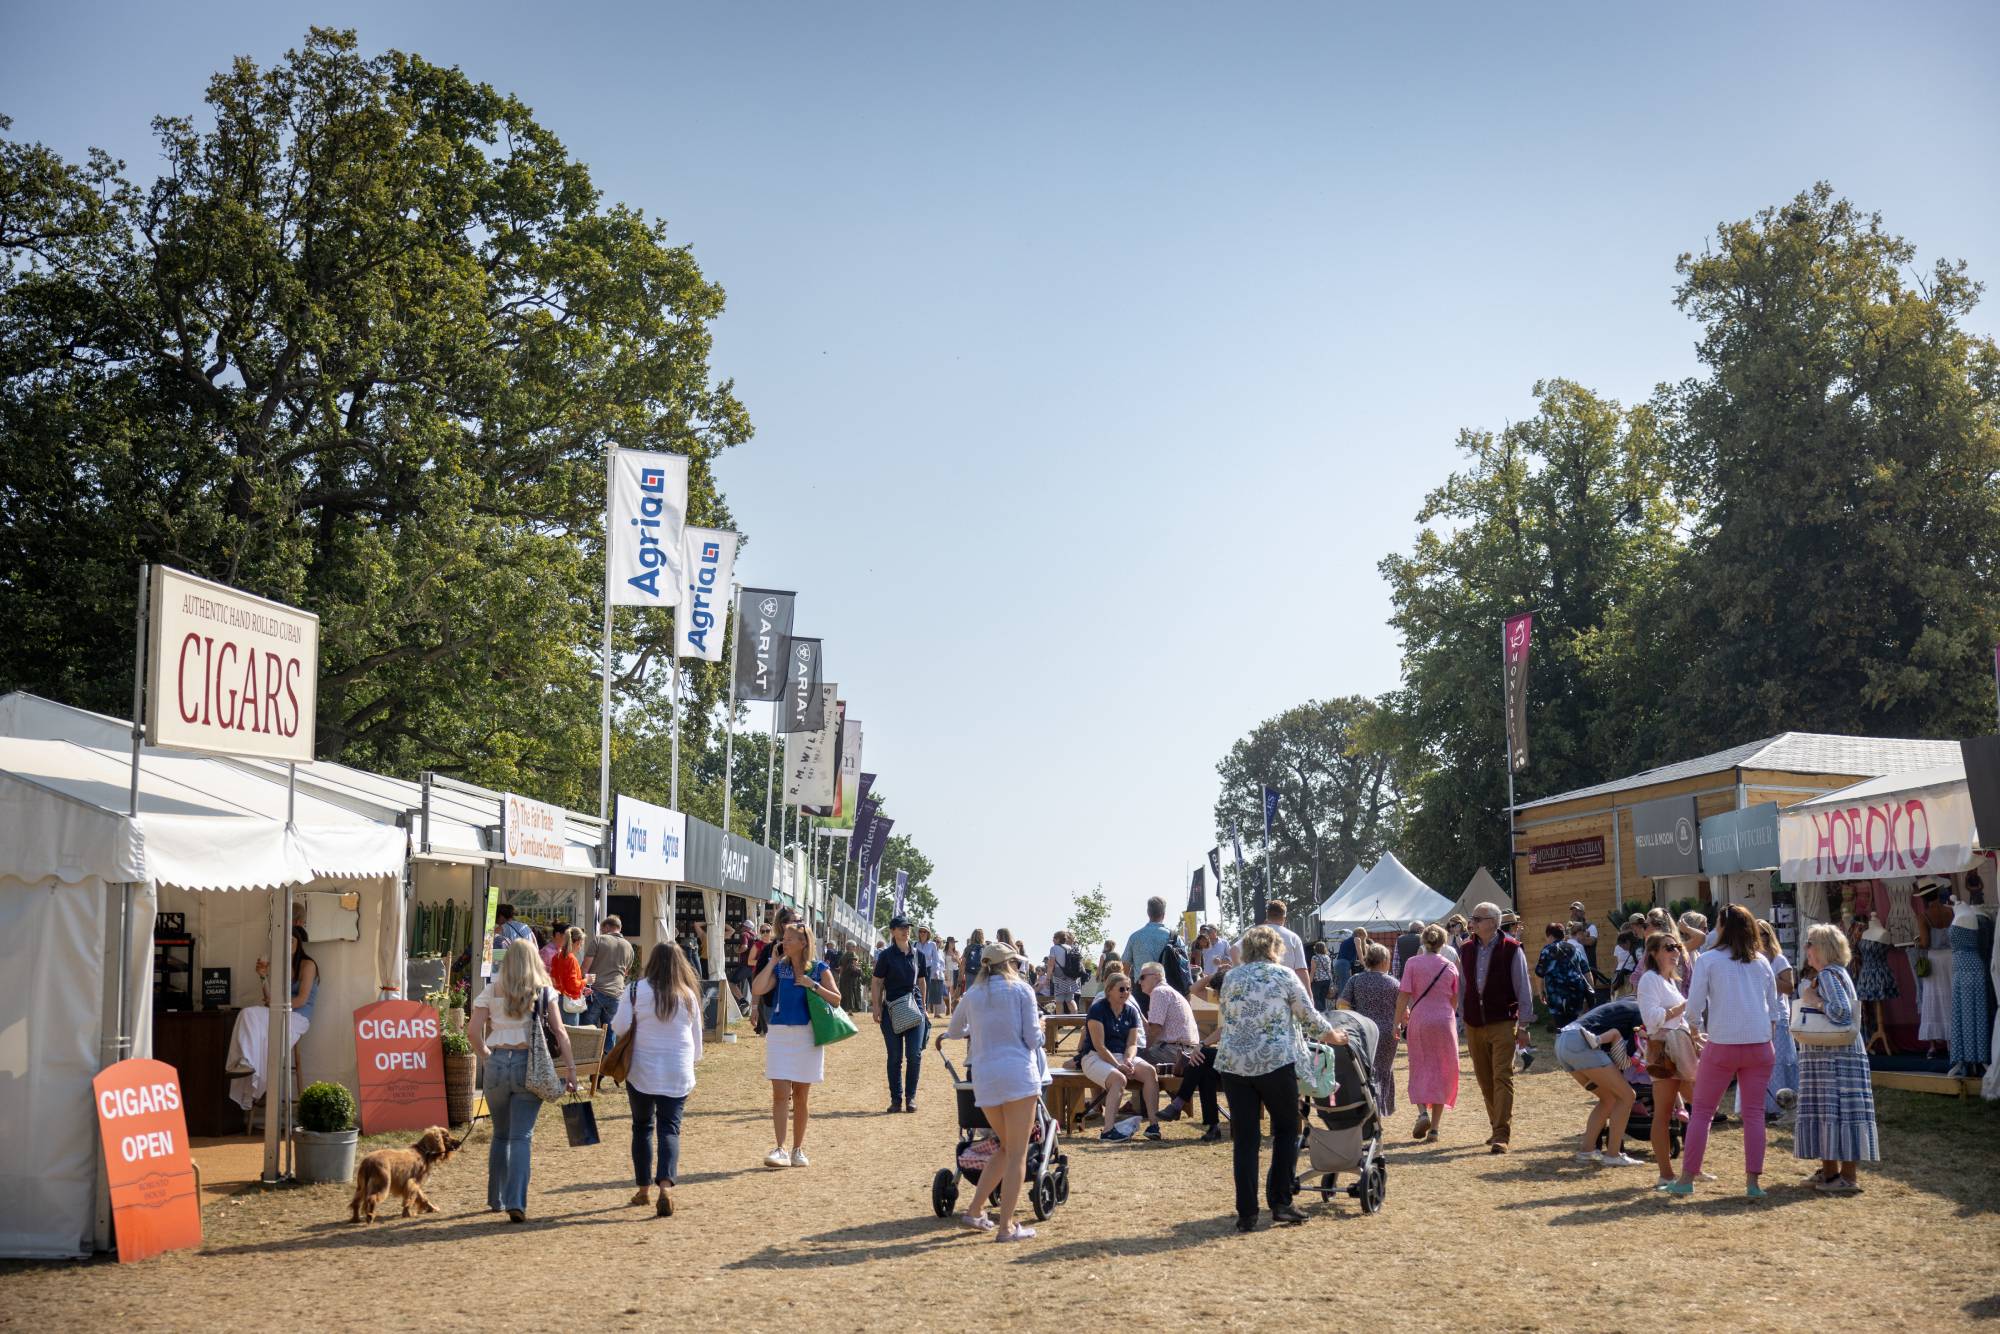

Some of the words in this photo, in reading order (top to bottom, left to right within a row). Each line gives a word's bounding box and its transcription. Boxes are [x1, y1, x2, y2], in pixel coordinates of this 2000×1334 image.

[627, 497, 667, 598] Agria
[182, 593, 228, 625] AUTHENTIC
[229, 606, 251, 630] HAND
[252, 613, 279, 638] ROLLED
[279, 622, 302, 644] CUBAN
[687, 567, 717, 653] Agria
[755, 618, 772, 690] ARIAT
[178, 632, 300, 738] CIGARS
[796, 661, 808, 722] ARIAT
[520, 800, 531, 826] The
[531, 806, 540, 828] Fair
[540, 808, 554, 832] Trade
[520, 832, 543, 856] Furniture
[543, 836, 565, 866] Company
[626, 816, 645, 859] Agria
[662, 826, 676, 864] Agria
[861, 818, 878, 872] LeMieux
[1536, 846, 1566, 863] MONARCH
[1566, 840, 1601, 858] EQUESTRIAN
[1658, 831, 1674, 846] MOON
[1811, 799, 1931, 875] HOBOKO
[726, 850, 748, 883] ARIAT
[359, 1019, 438, 1039] CIGARS
[375, 1052, 427, 1071] OPEN
[100, 1082, 180, 1120] CIGARS
[121, 1130, 175, 1163] OPEN
